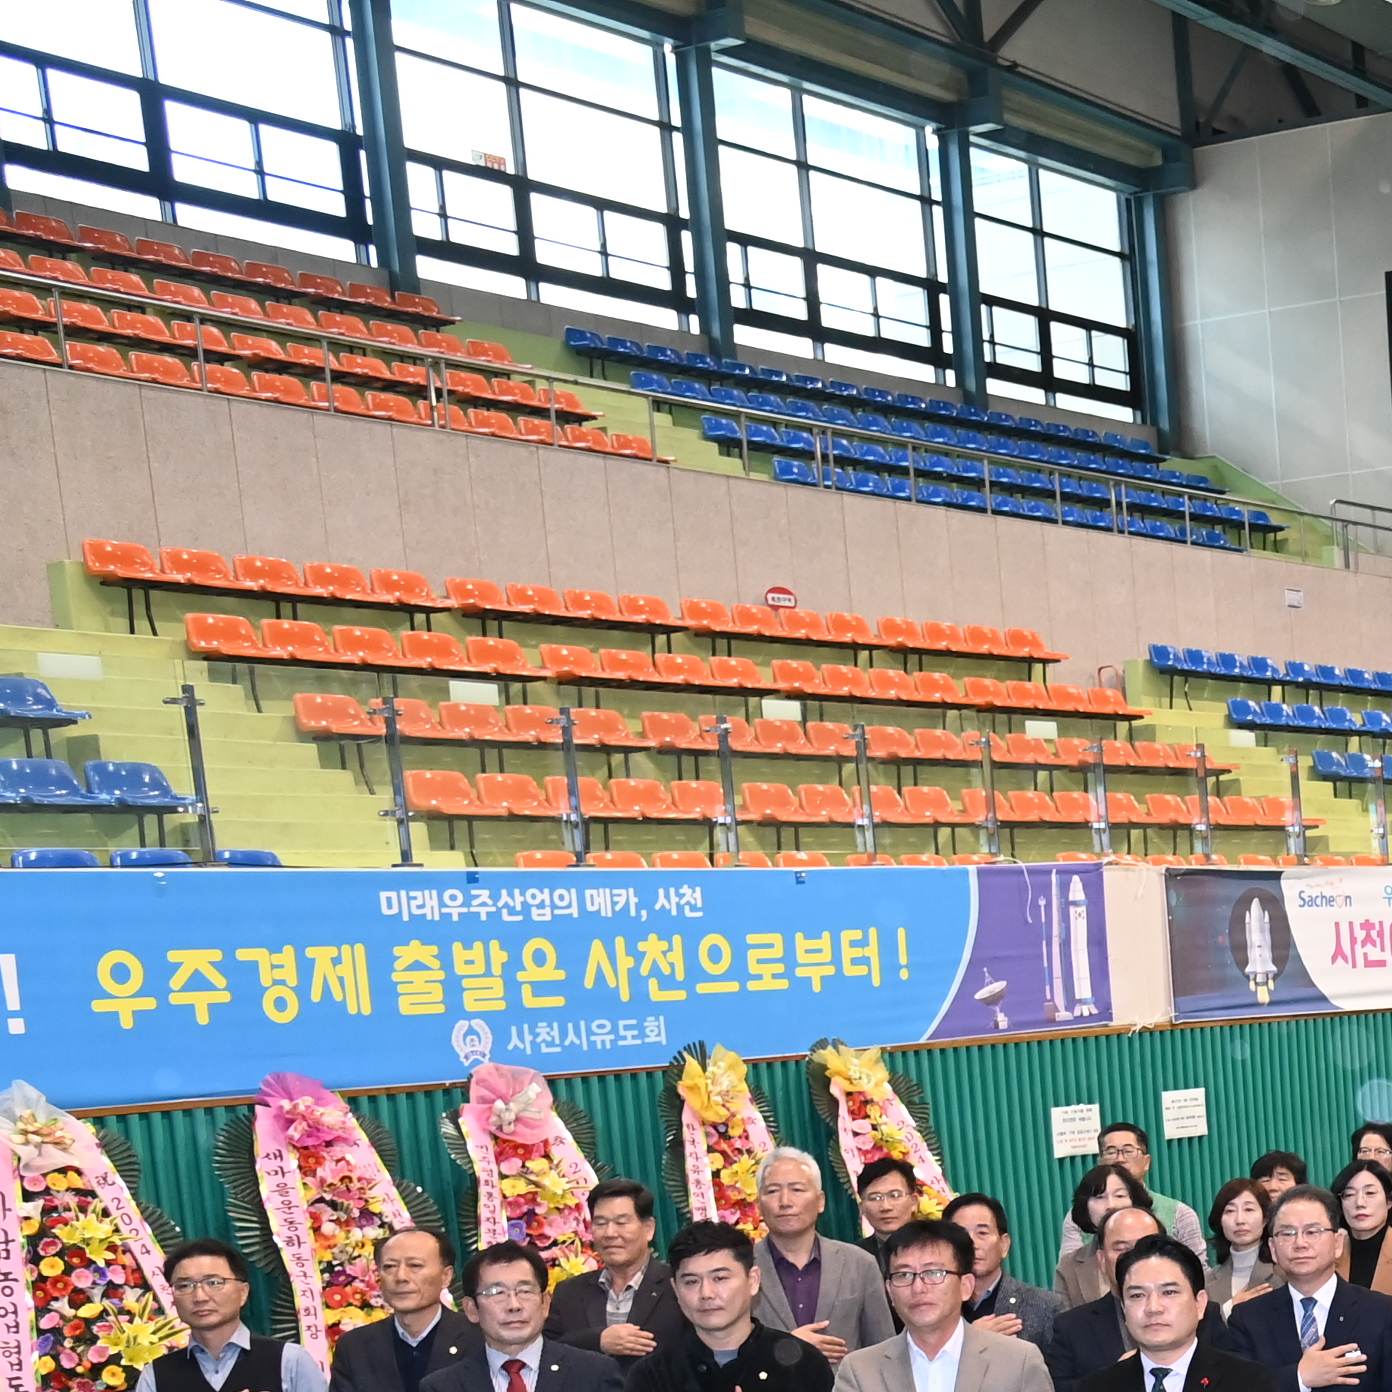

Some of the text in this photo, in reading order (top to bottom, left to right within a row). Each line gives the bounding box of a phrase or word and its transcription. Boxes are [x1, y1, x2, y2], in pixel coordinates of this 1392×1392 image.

[379, 884, 704, 922] 미래우주산업의 메카, 사천
[91, 943, 371, 1030] 우주경제
[391, 937, 566, 1015] 출발은
[507, 1014, 667, 1056] 사천시유도회
[110, 1196, 152, 1257] 2024
